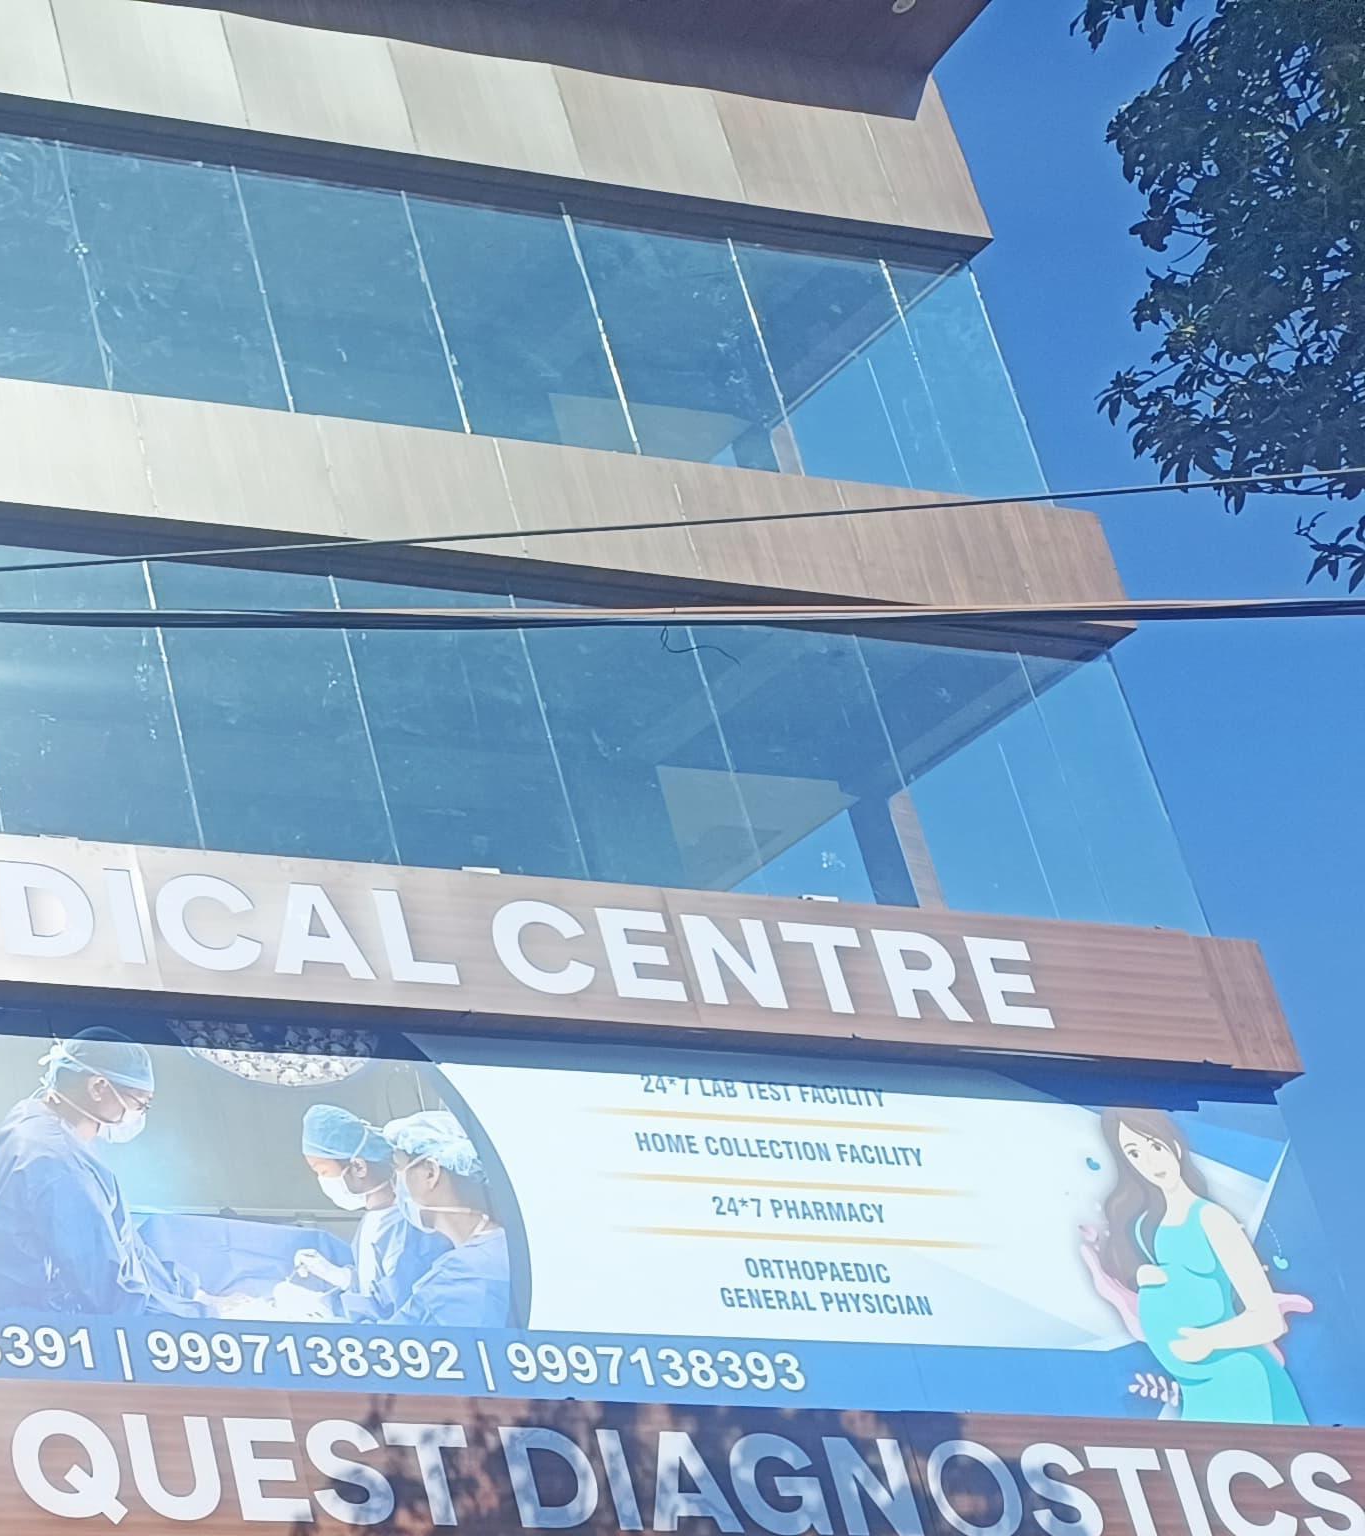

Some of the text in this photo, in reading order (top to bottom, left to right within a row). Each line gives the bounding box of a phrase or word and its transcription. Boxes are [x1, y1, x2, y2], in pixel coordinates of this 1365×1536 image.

[491, 900, 1056, 1029] CENTRE
[698, 1078, 737, 1098] LAB
[741, 1081, 793, 1102] TEST
[799, 1084, 885, 1107] FACILITY
[634, 1132, 923, 1168] HOME COLLECTION FACILITY
[770, 1199, 885, 1224] PHARMACY
[744, 1257, 891, 1285] ORTHOPAEDIC
[719, 1287, 933, 1317] GENERAL PHYSICIAN
[148, 1329, 465, 1381] 9997138392
[508, 1341, 807, 1392] 9997138393
[11, 1418, 459, 1529] QUEST
